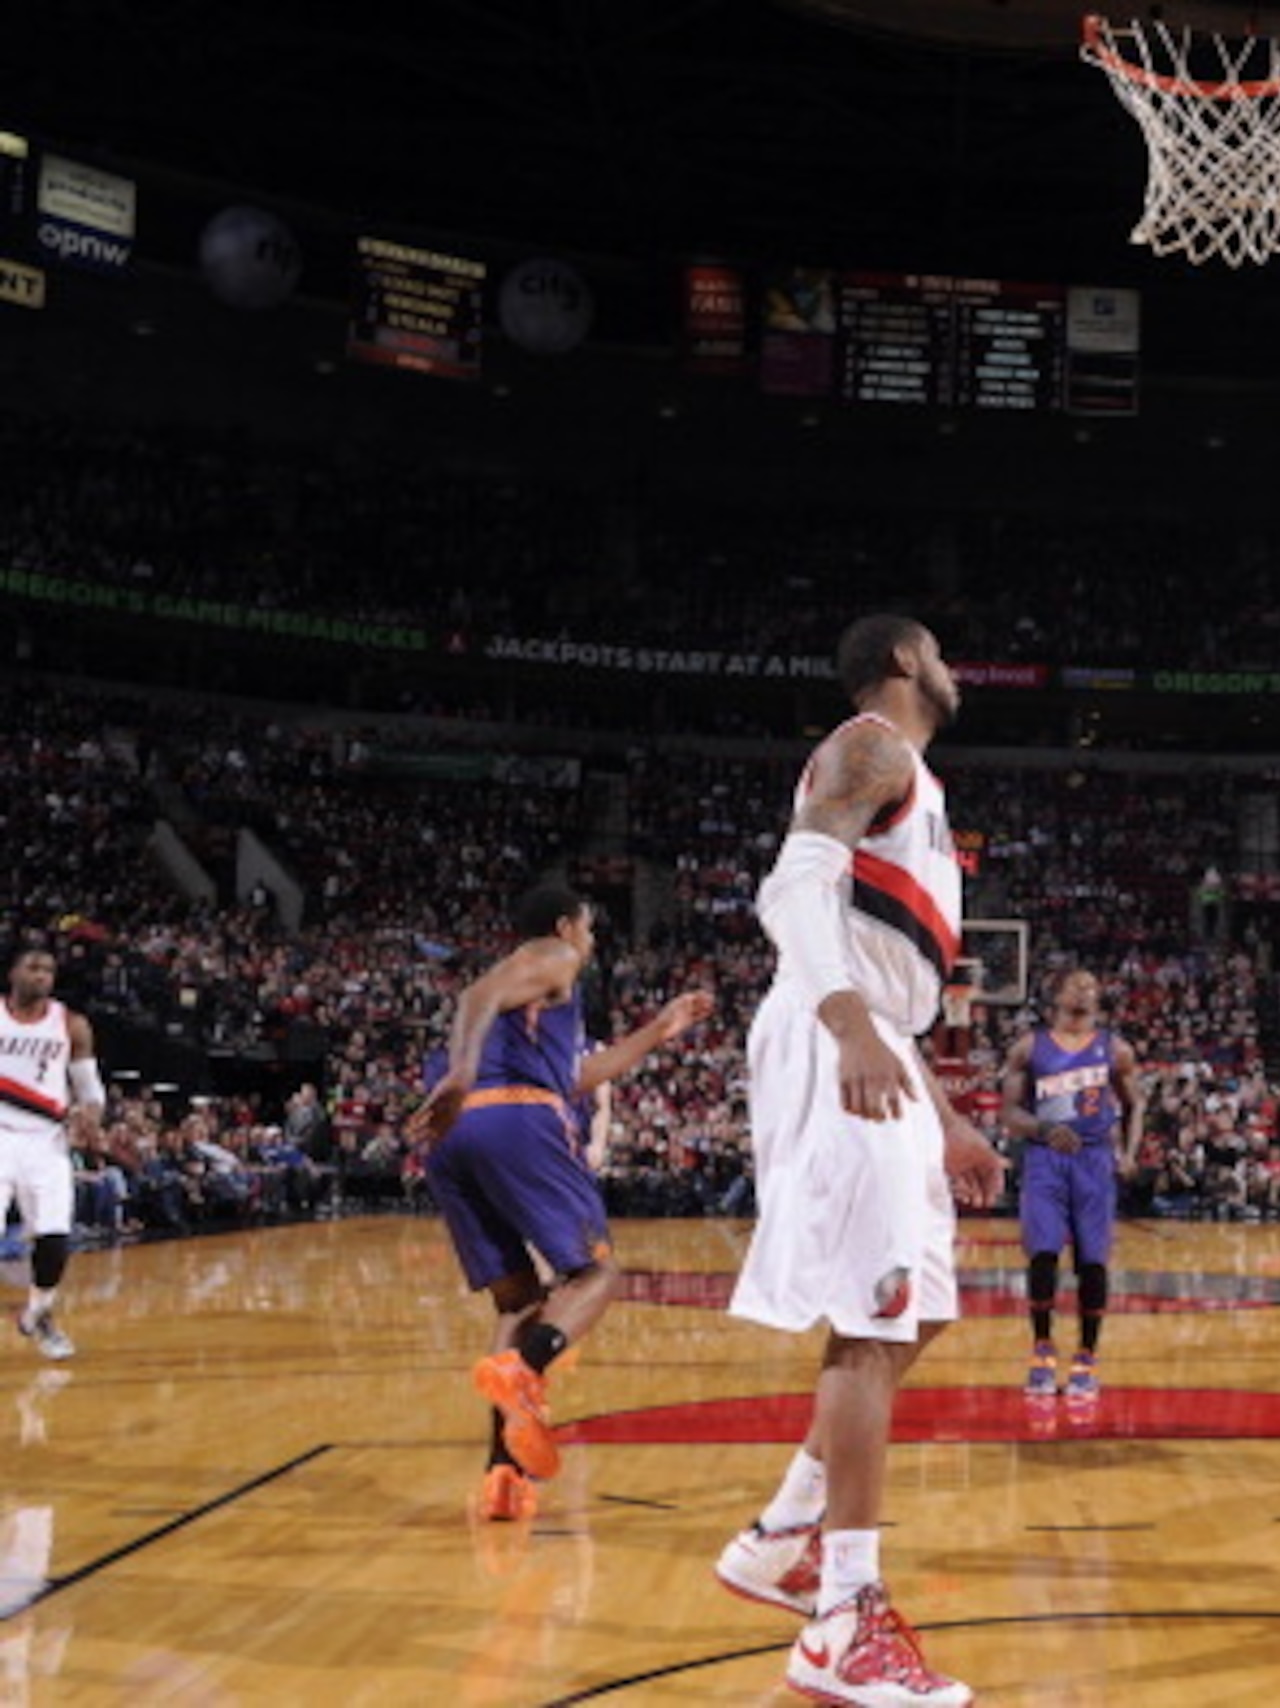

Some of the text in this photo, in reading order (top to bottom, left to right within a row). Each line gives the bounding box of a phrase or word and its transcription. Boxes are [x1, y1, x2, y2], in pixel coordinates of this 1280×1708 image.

[484, 634, 631, 670] JACKPOTS
[636, 649, 723, 675] START
[725, 654, 760, 676] AT
[764, 654, 786, 677] A
